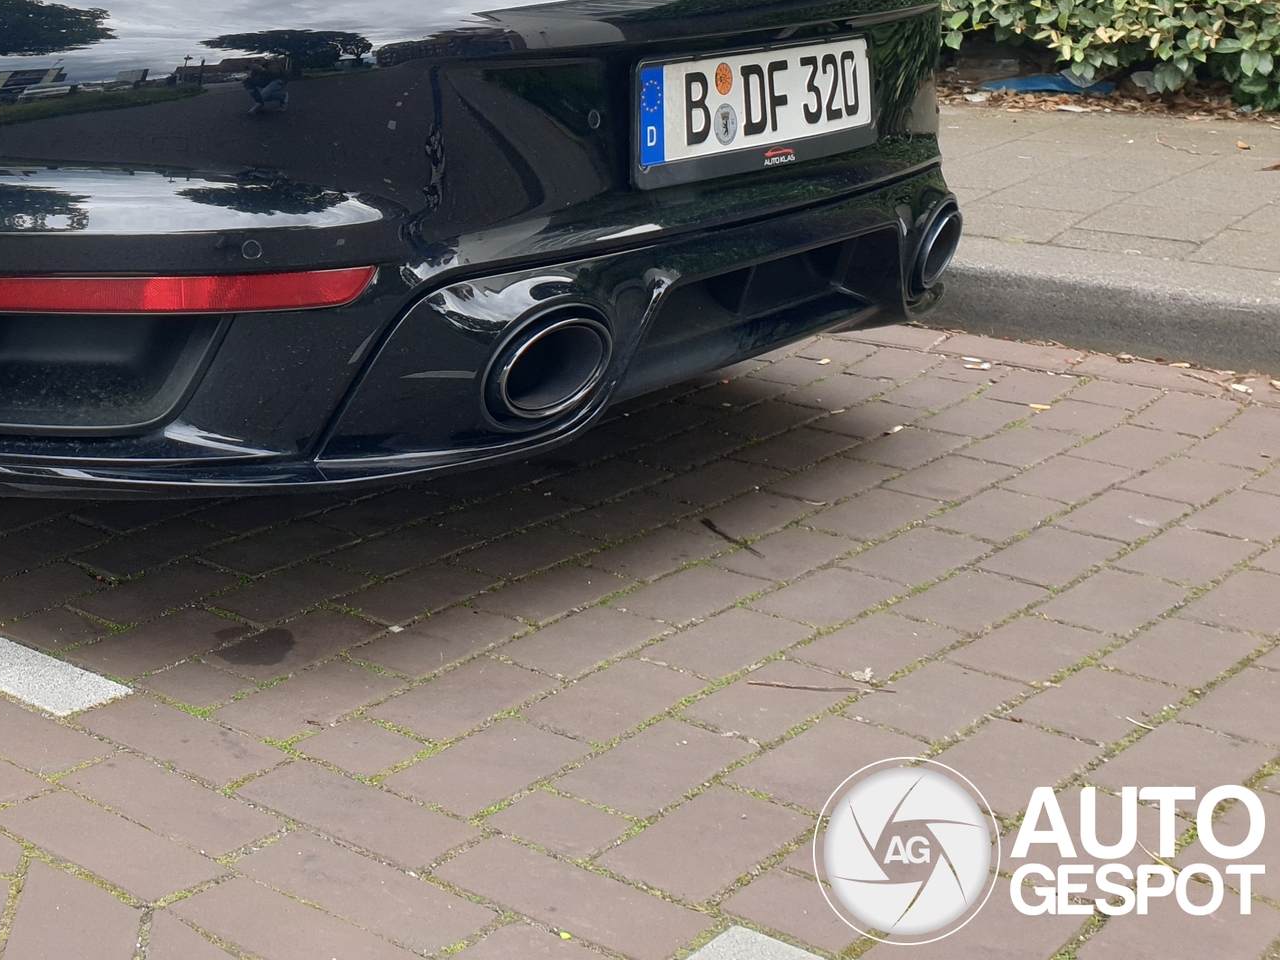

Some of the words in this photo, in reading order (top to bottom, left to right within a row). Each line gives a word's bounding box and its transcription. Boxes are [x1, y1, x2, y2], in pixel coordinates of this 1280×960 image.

[685, 71, 711, 146] B
[740, 59, 788, 137] DF
[799, 50, 860, 125] 320
[646, 125, 657, 147] D
[763, 156, 780, 166] AUTO
